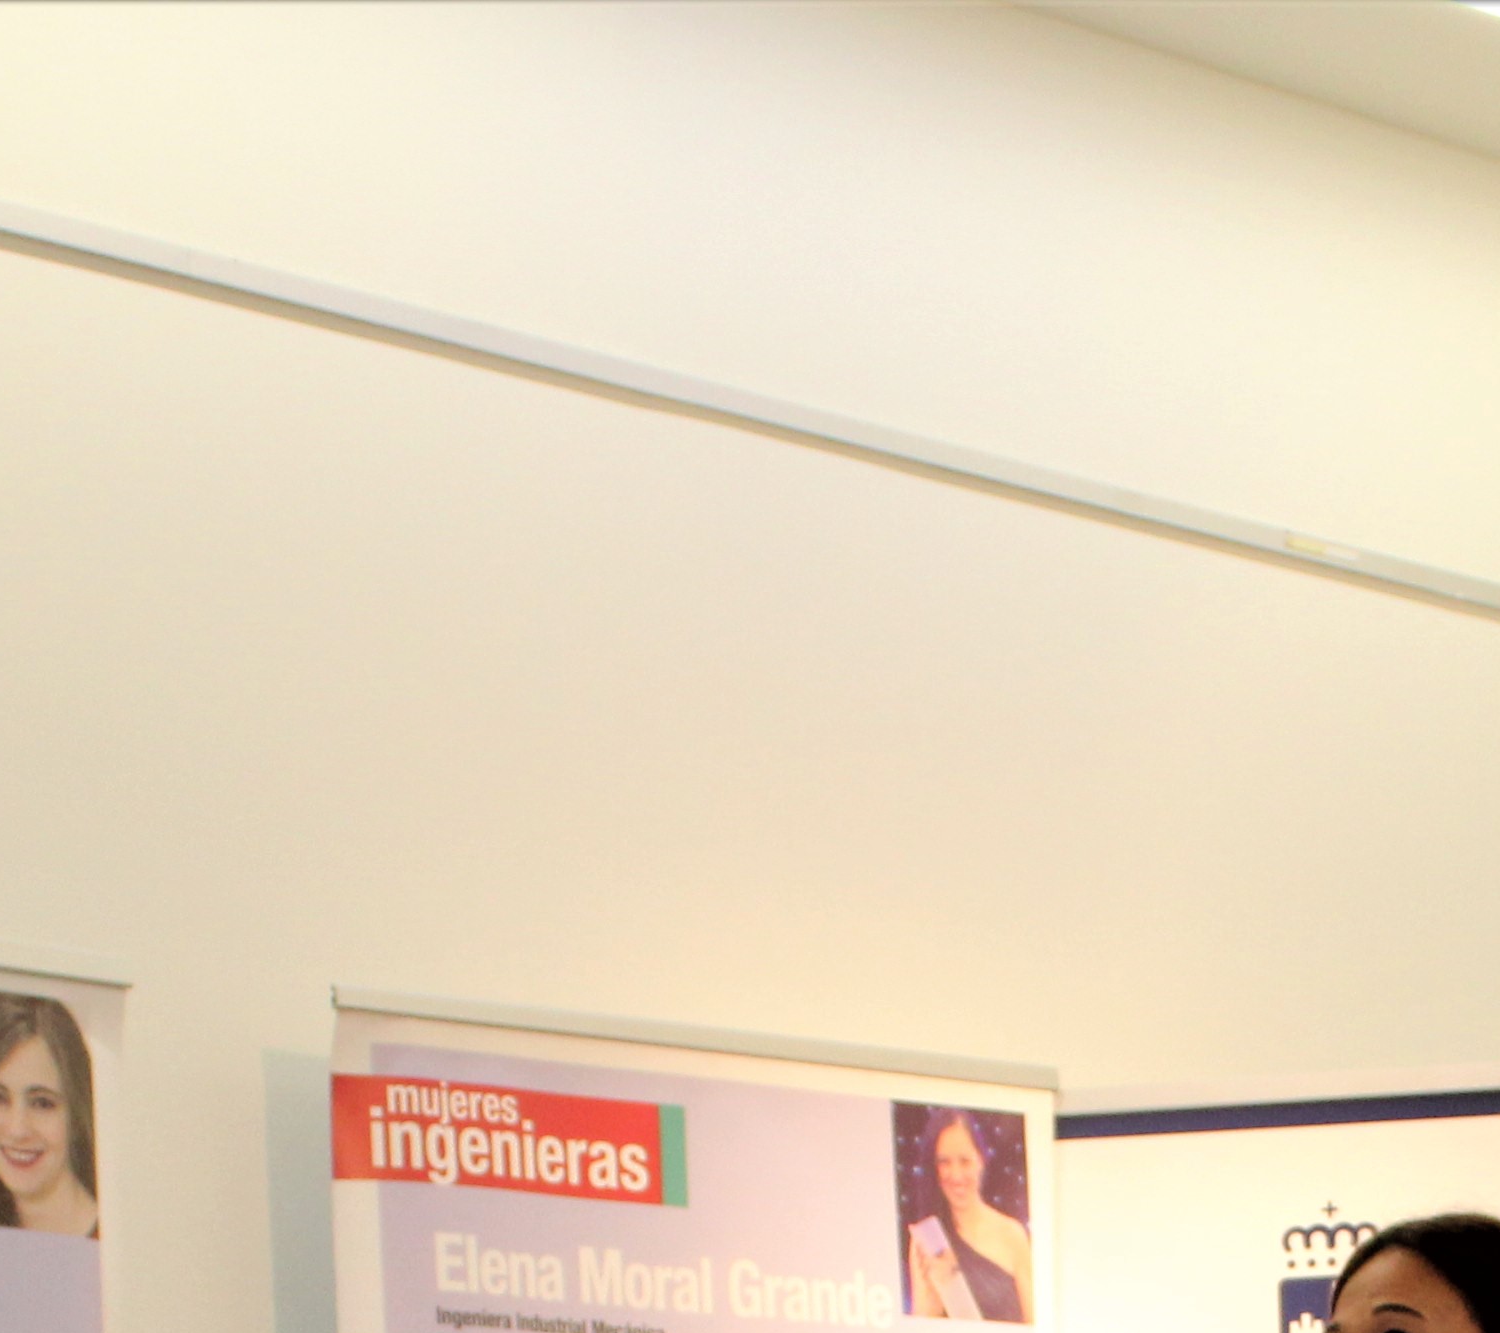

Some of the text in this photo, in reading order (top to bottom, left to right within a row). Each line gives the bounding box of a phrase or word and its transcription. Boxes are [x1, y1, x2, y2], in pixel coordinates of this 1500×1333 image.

[386, 1082, 519, 1124] mujeres
[370, 1107, 649, 1193] ingenieras
[435, 1232, 893, 1329] Elena Moral Grande
[436, 1306, 512, 1329] Ingeniera
